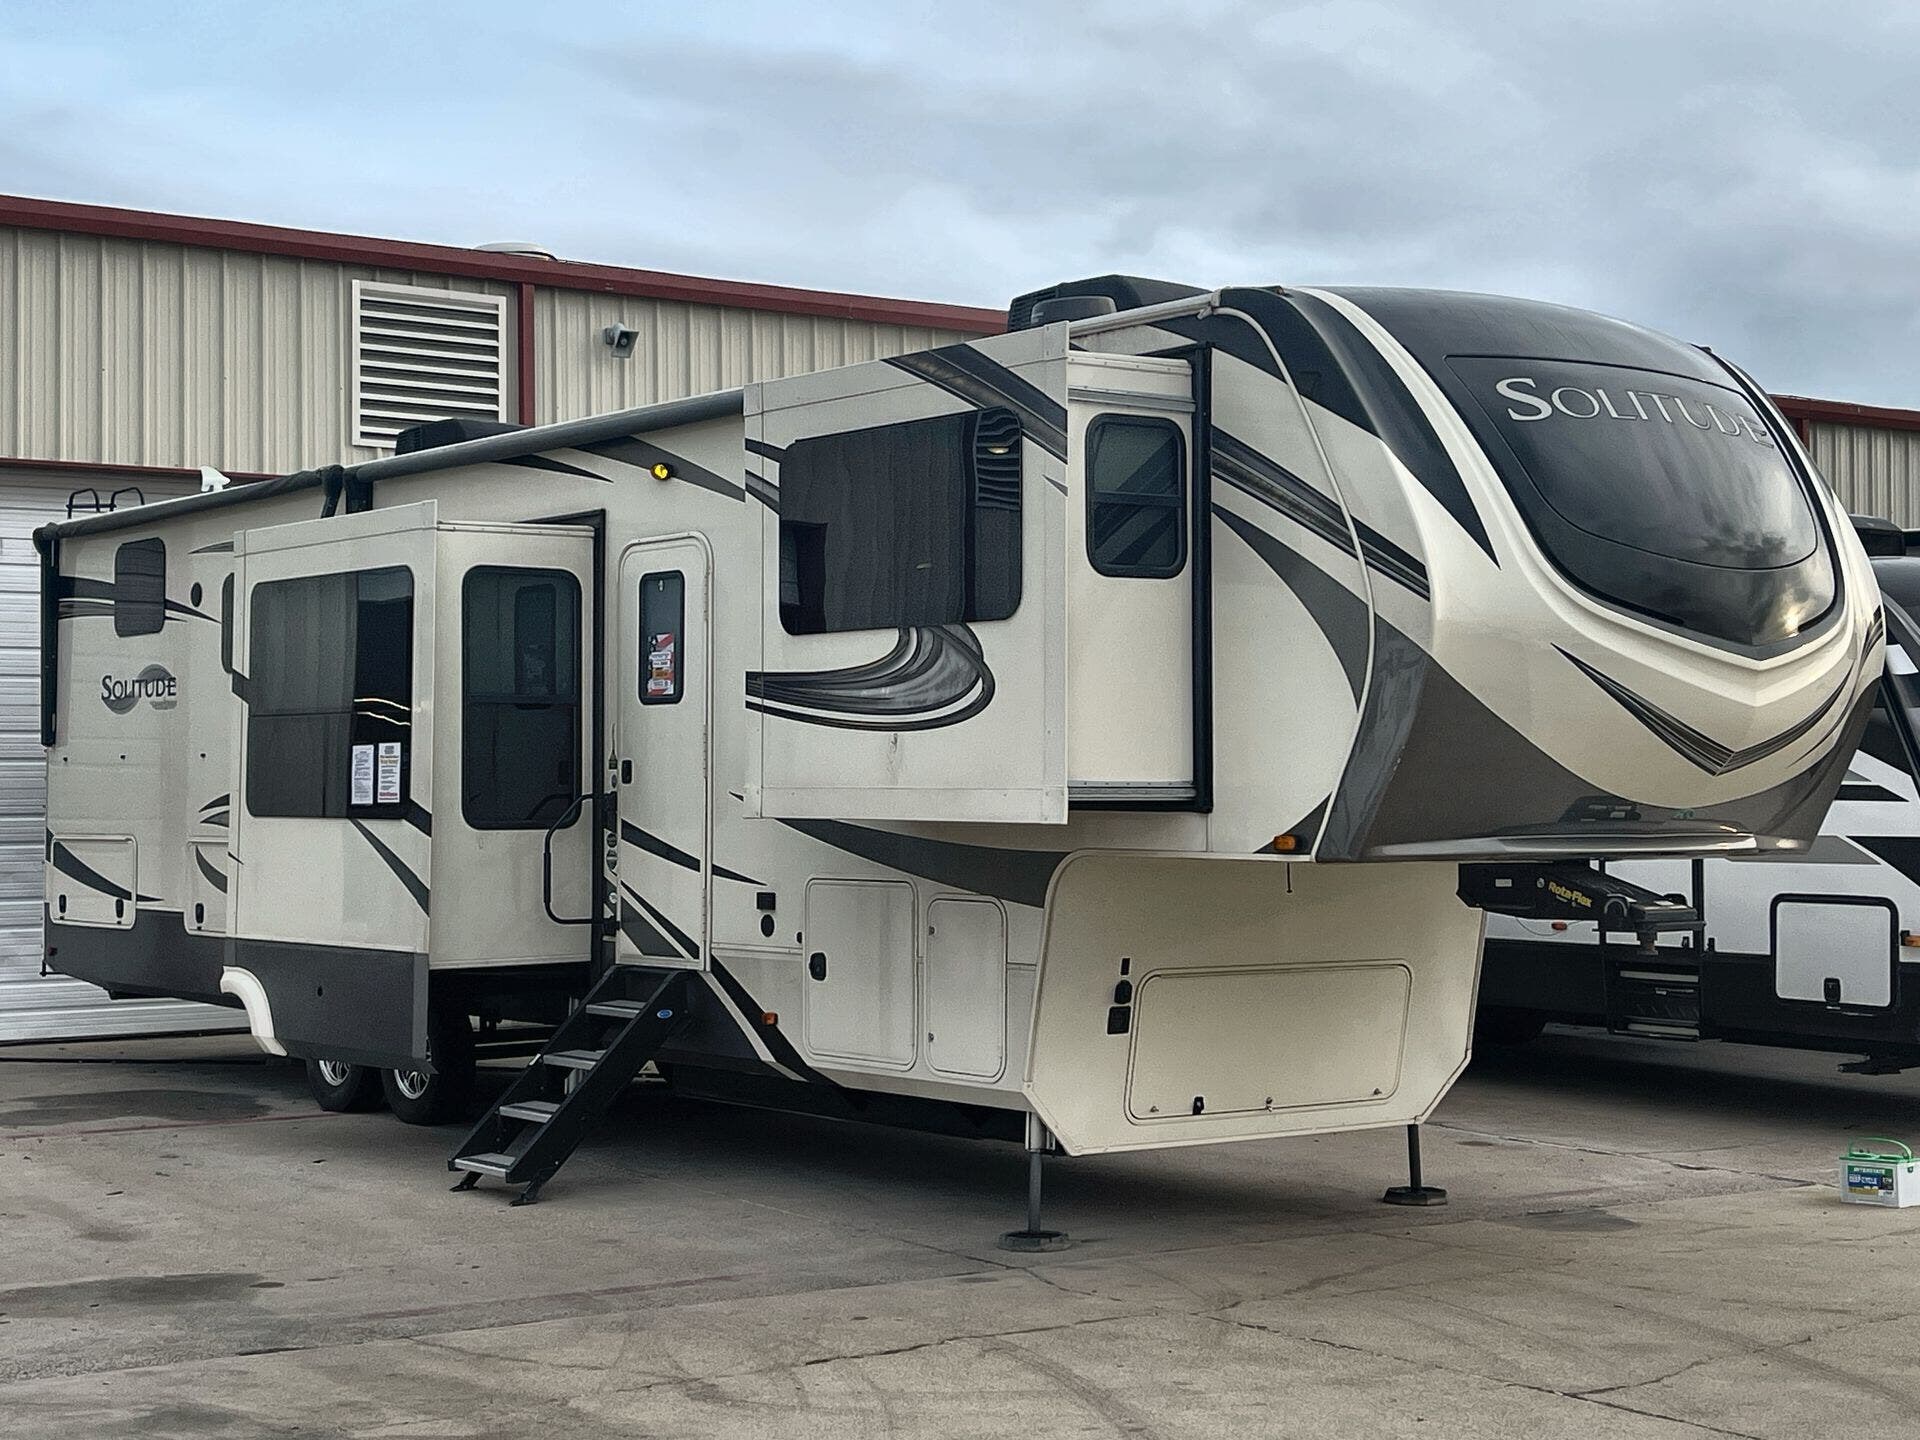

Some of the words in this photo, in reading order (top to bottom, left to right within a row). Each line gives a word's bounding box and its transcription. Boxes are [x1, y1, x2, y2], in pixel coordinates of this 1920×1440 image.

[1495, 376, 1775, 450] SOLITUDE
[101, 674, 177, 700] SOLITUDE
[1549, 881, 1592, 907] Rota-Flex
